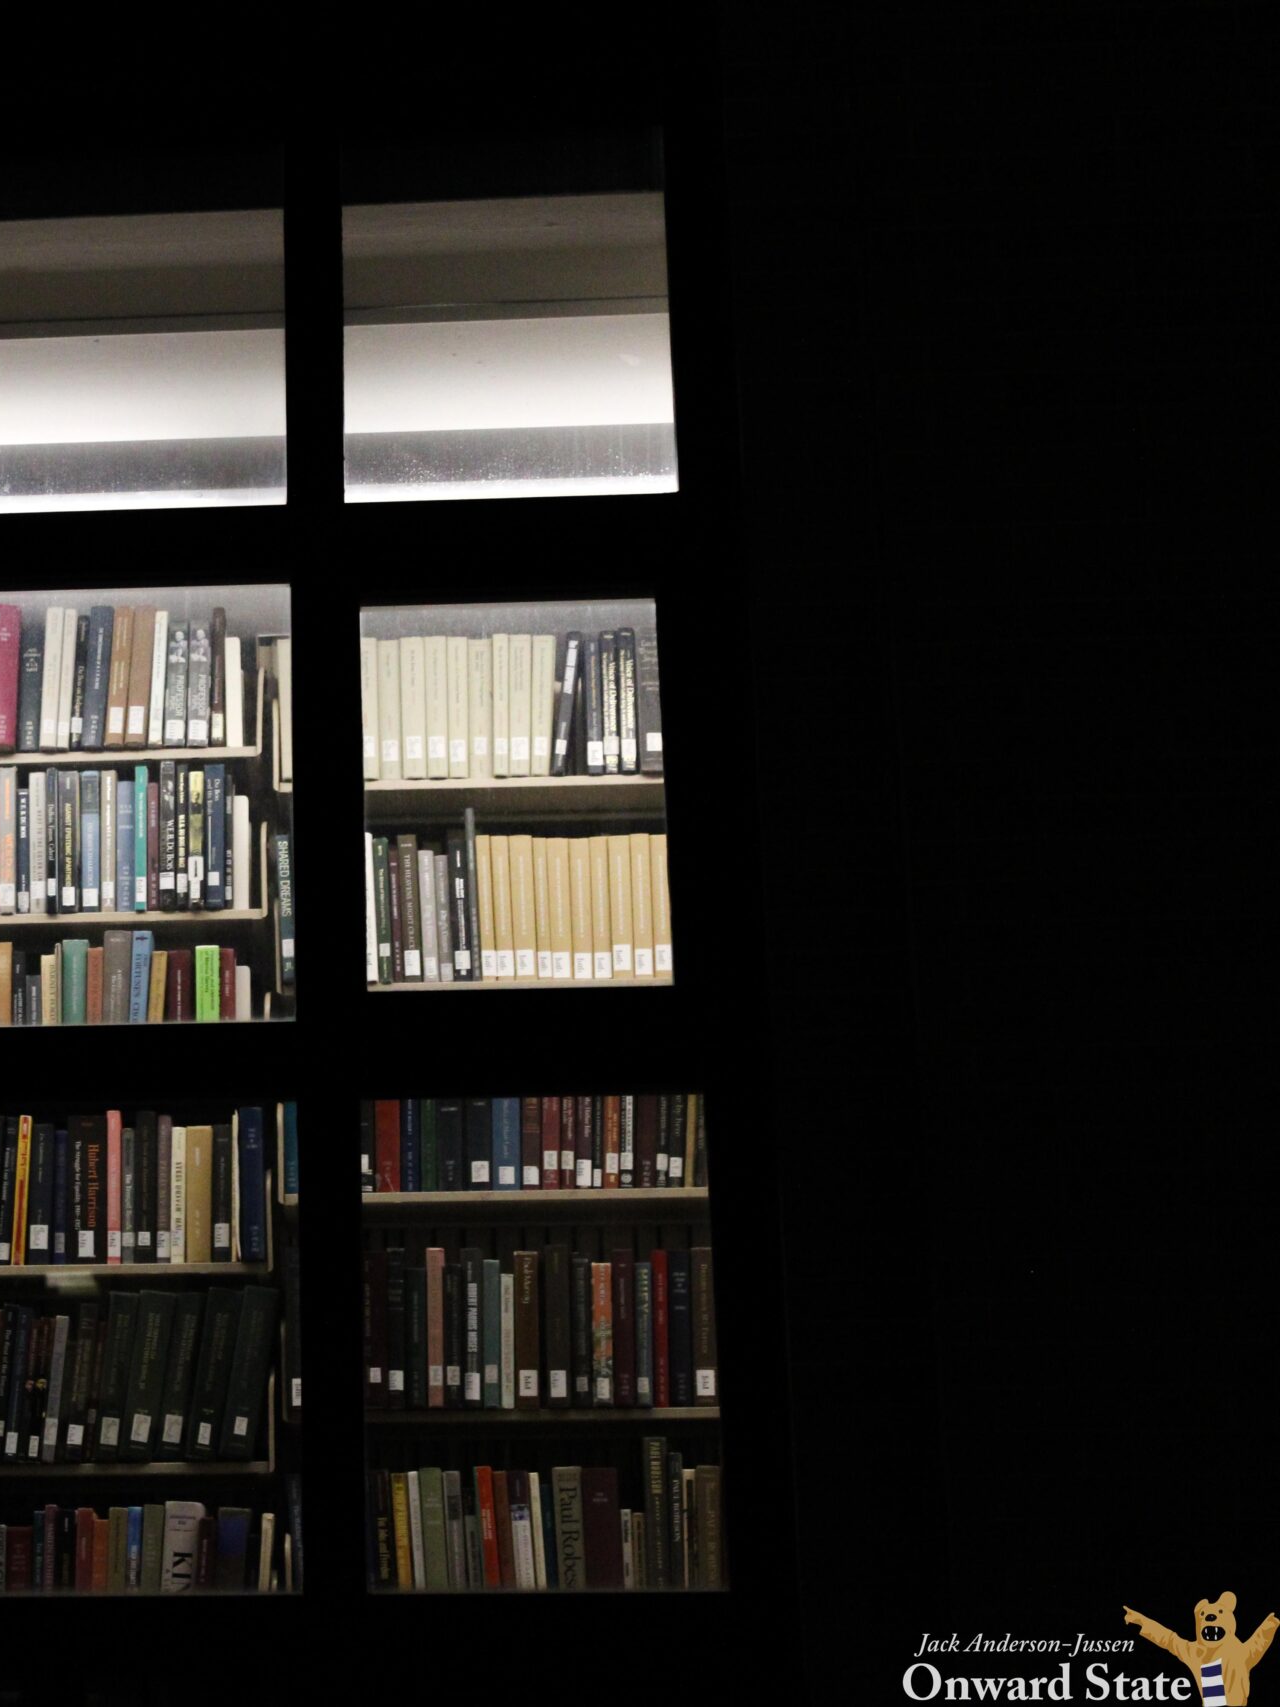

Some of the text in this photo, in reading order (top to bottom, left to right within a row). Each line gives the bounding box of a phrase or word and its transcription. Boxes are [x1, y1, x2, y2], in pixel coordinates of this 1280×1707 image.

[608, 662, 616, 680] Voice
[625, 659, 633, 677] Voice
[176, 675, 185, 716] PROFESSOR
[197, 674, 207, 716] PROFESSOR
[626, 688, 634, 729] Deliverance
[608, 690, 617, 731] Deliverance
[214, 779, 221, 788] Du
[166, 819, 175, 841] W.E.B.
[166, 843, 174, 852] DU
[277, 841, 292, 917] SHARED DREAMS
[404, 870, 412, 900] HEAVENS
[406, 902, 414, 924] MIGHT
[407, 926, 415, 950] CRACK
[73, 1151, 82, 1172] Struggle
[87, 1143, 99, 1227] Hubert Harrison
[649, 1441, 662, 1459] PAUL
[649, 1461, 663, 1494] ROBESON
[672, 1479, 681, 1542] PAUL ROBESON
[559, 1487, 582, 1585] Paul Robes
